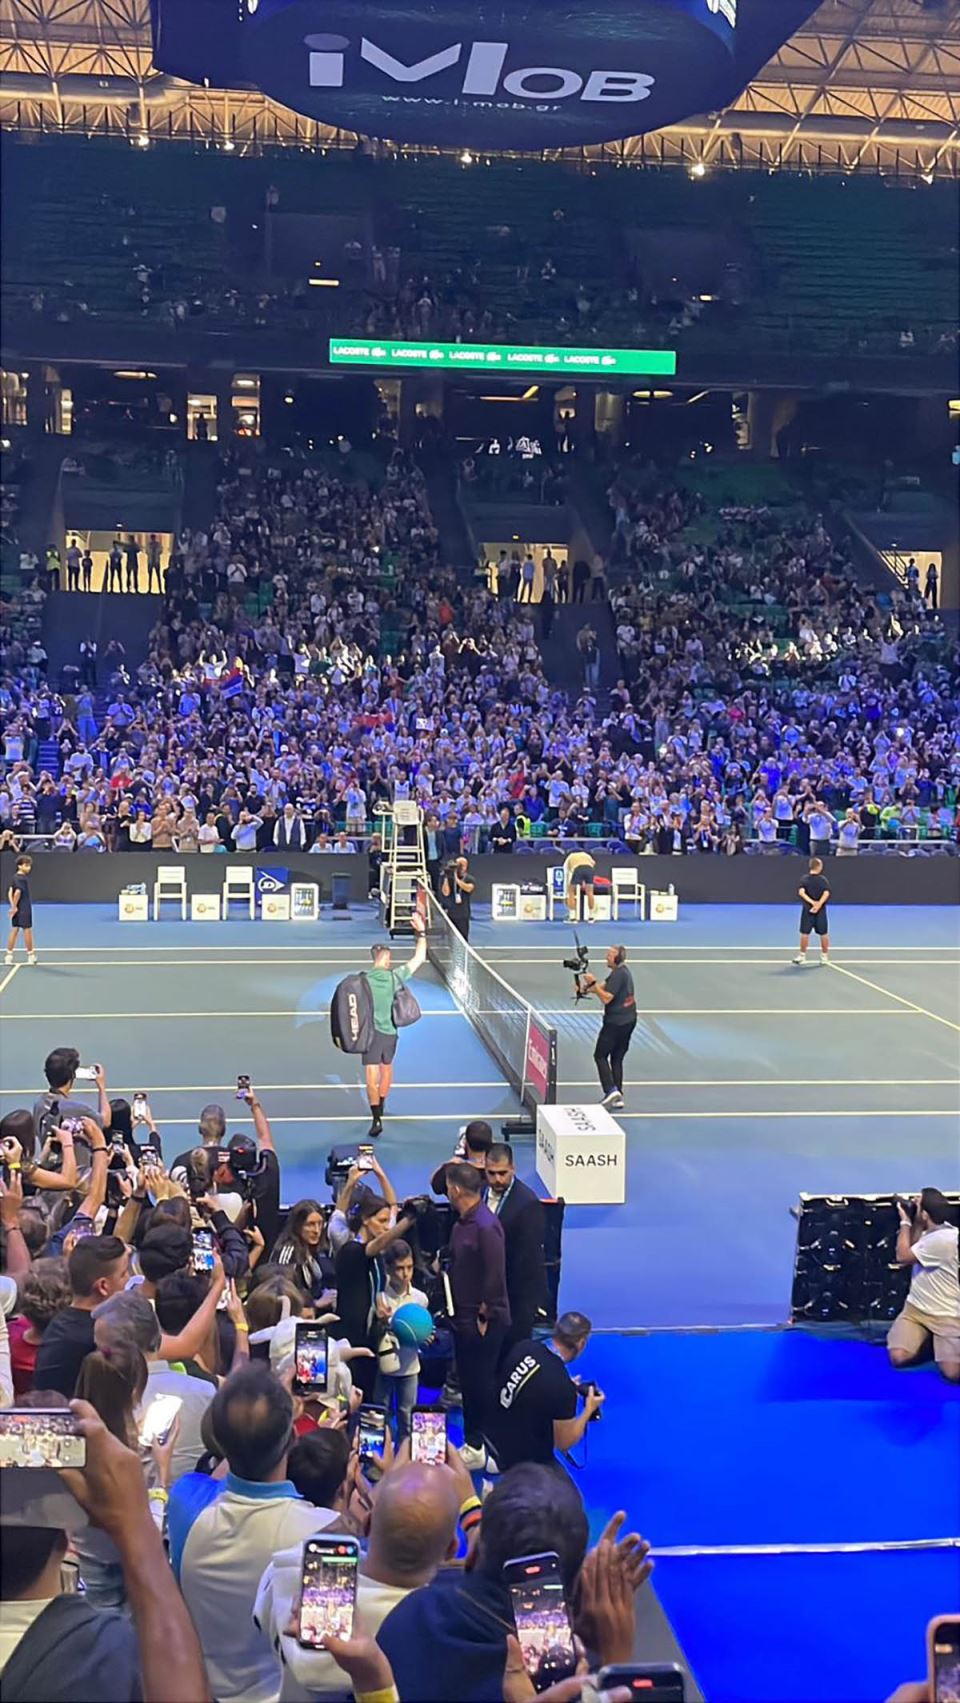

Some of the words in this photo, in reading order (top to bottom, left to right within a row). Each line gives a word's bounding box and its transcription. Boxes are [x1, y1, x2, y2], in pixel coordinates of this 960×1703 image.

[333, 346, 370, 356] LACOSTE
[391, 349, 428, 359] LACOSTE
[449, 351, 485, 360] LACOSTE
[507, 353, 543, 363] LACOSTE
[564, 355, 600, 365] LACOSTE
[348, 993, 360, 1042] HEAD
[565, 1154, 618, 1167] SAASH
